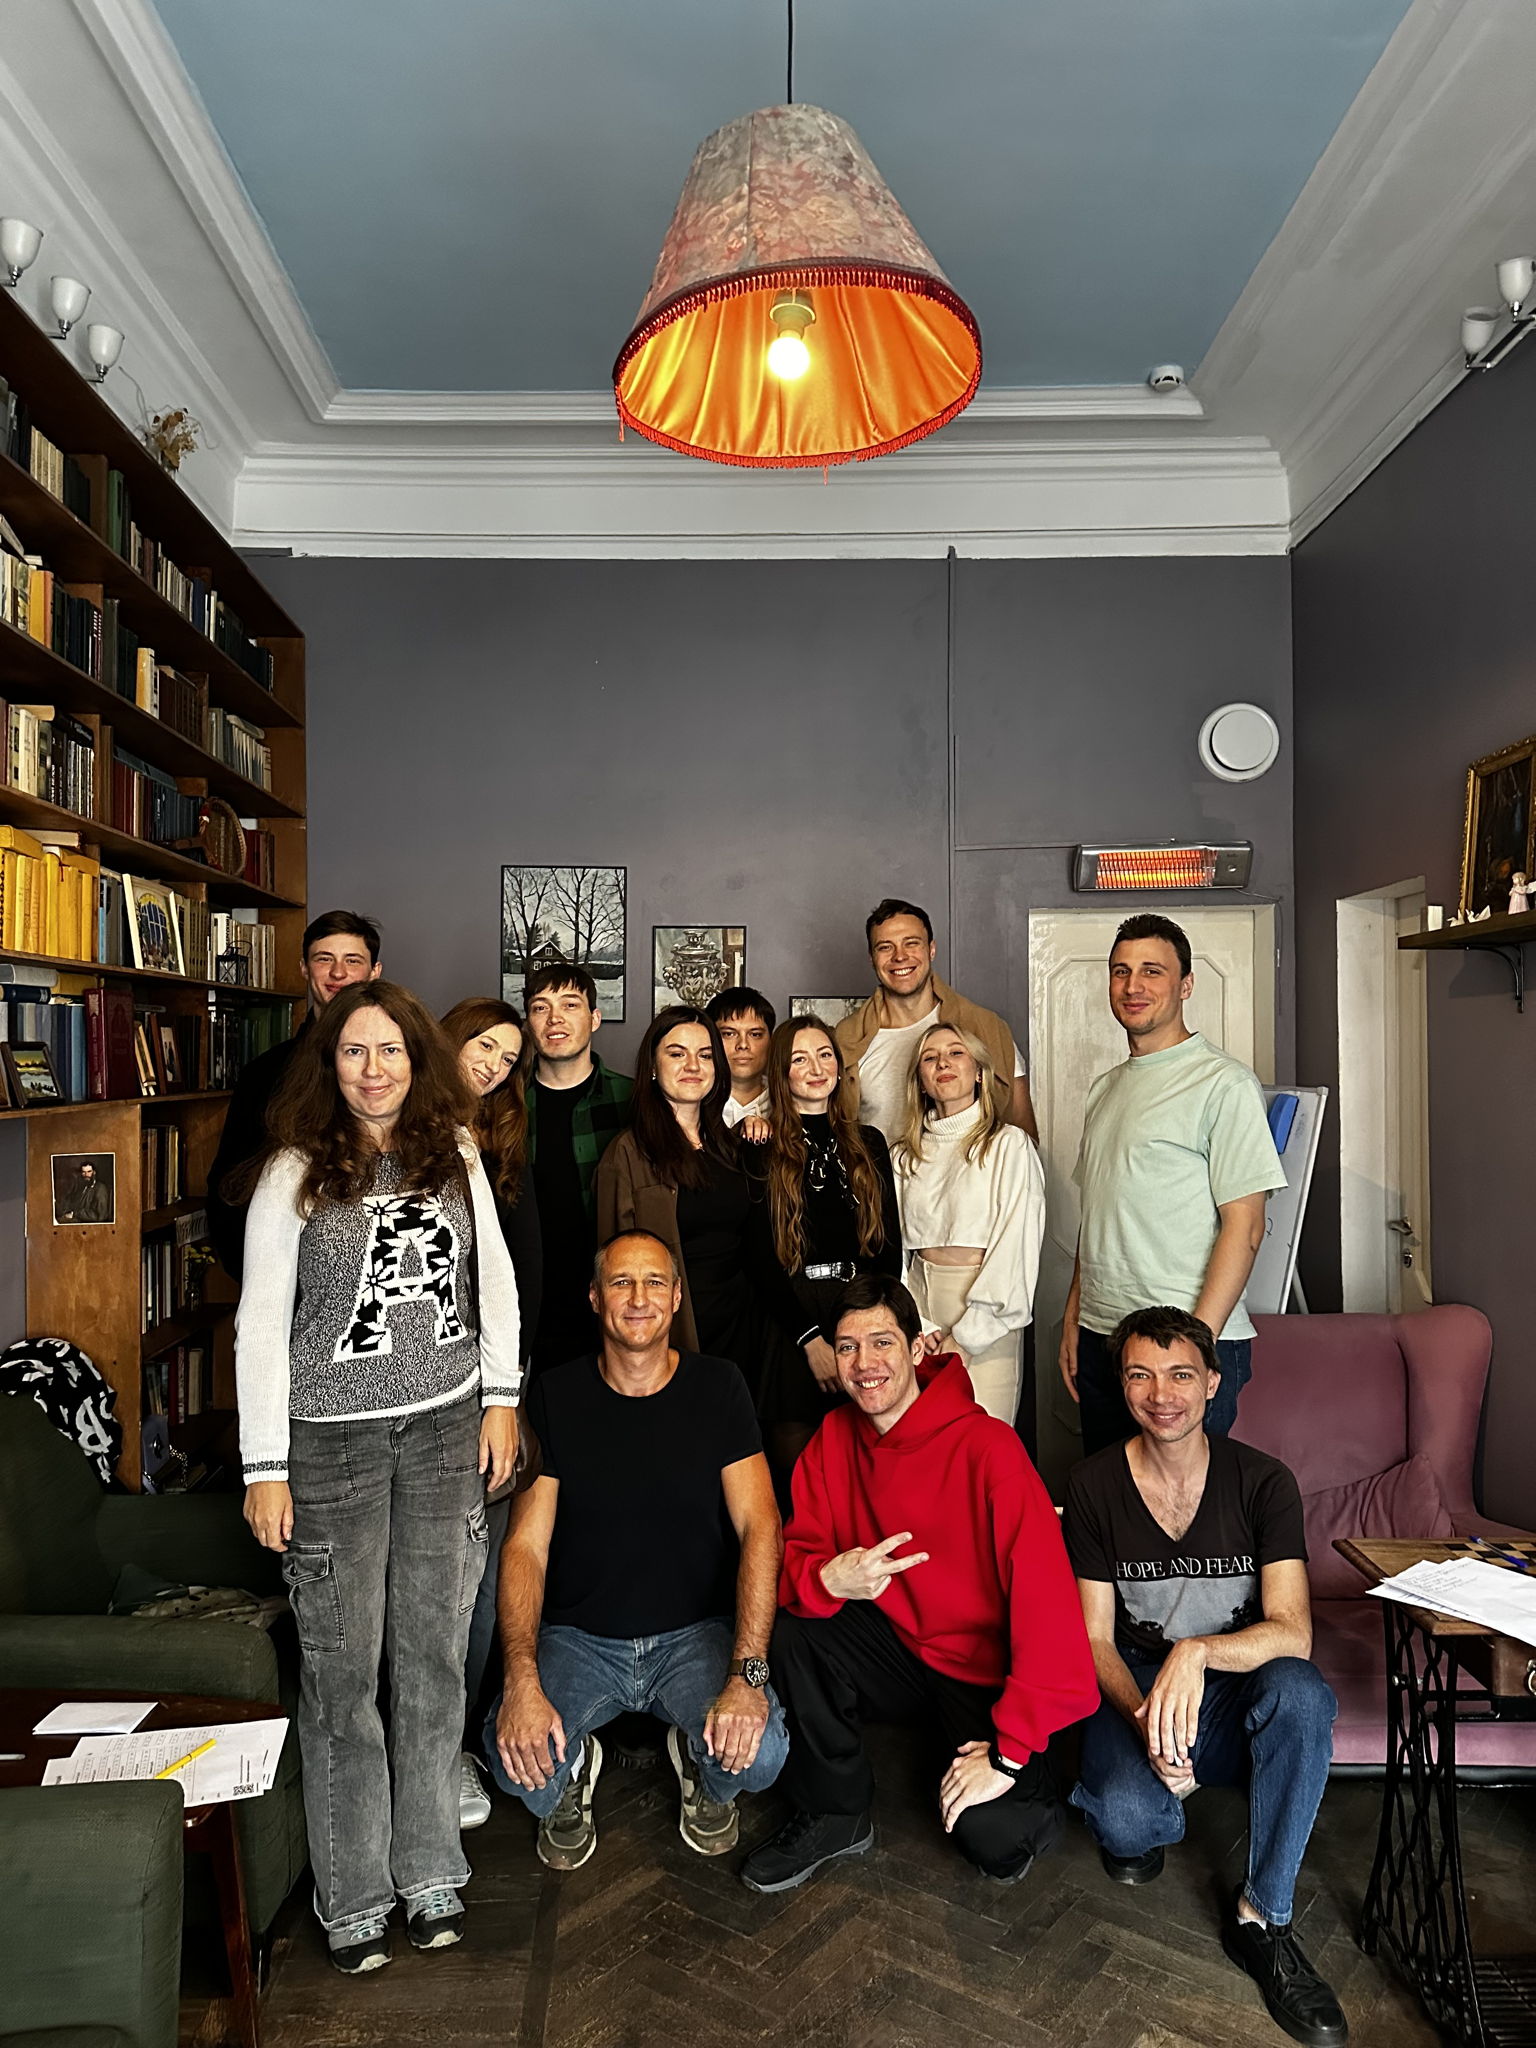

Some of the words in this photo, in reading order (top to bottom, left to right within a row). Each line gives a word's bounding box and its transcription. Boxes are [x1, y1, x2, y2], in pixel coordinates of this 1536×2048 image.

[333, 1193, 468, 1362] A
[1116, 1562, 1165, 1578] HOPE
[1170, 1557, 1202, 1576] AND
[1205, 1556, 1255, 1575] FEAR
